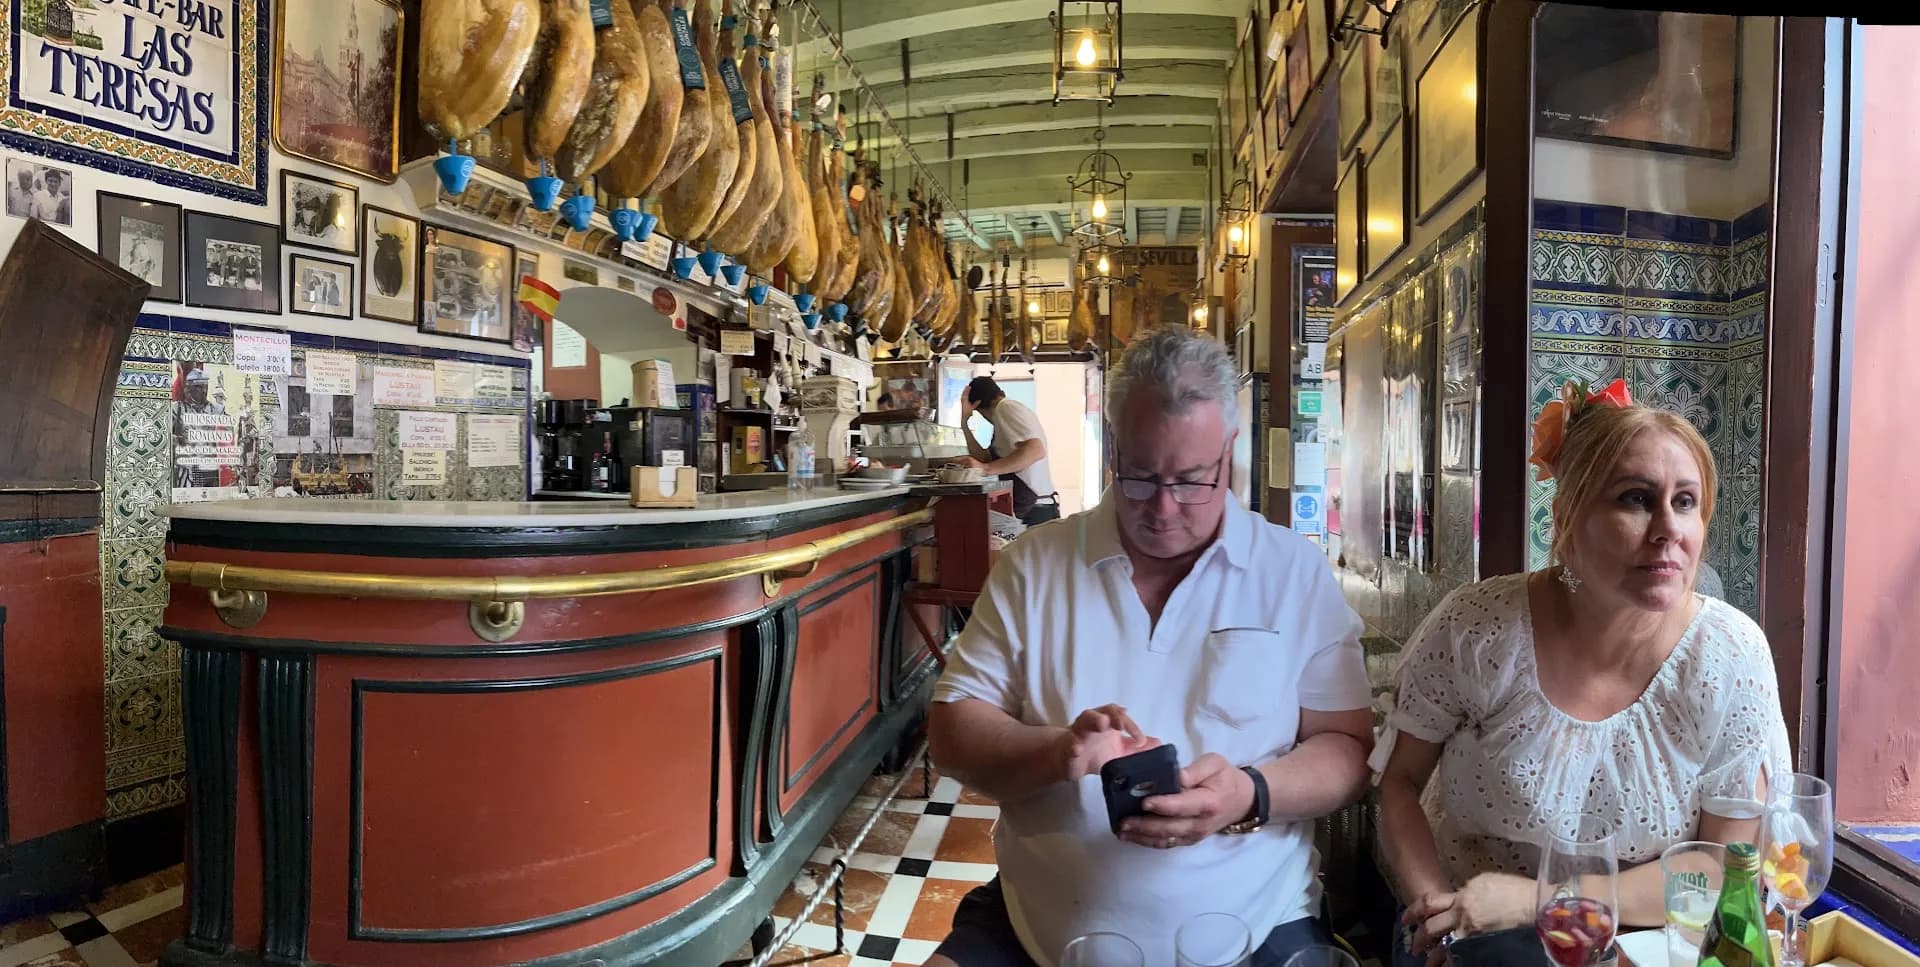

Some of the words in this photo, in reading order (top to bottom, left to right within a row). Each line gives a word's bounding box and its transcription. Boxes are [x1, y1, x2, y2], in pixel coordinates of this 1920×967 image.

[121, 14, 193, 76] LAS
[39, 43, 214, 135] TERESAS
[235, 334, 288, 345] MONTECILLO
[236, 353, 256, 362] Copa
[196, 414, 238, 425] JORNADAS
[188, 430, 233, 441] ROMANAS
